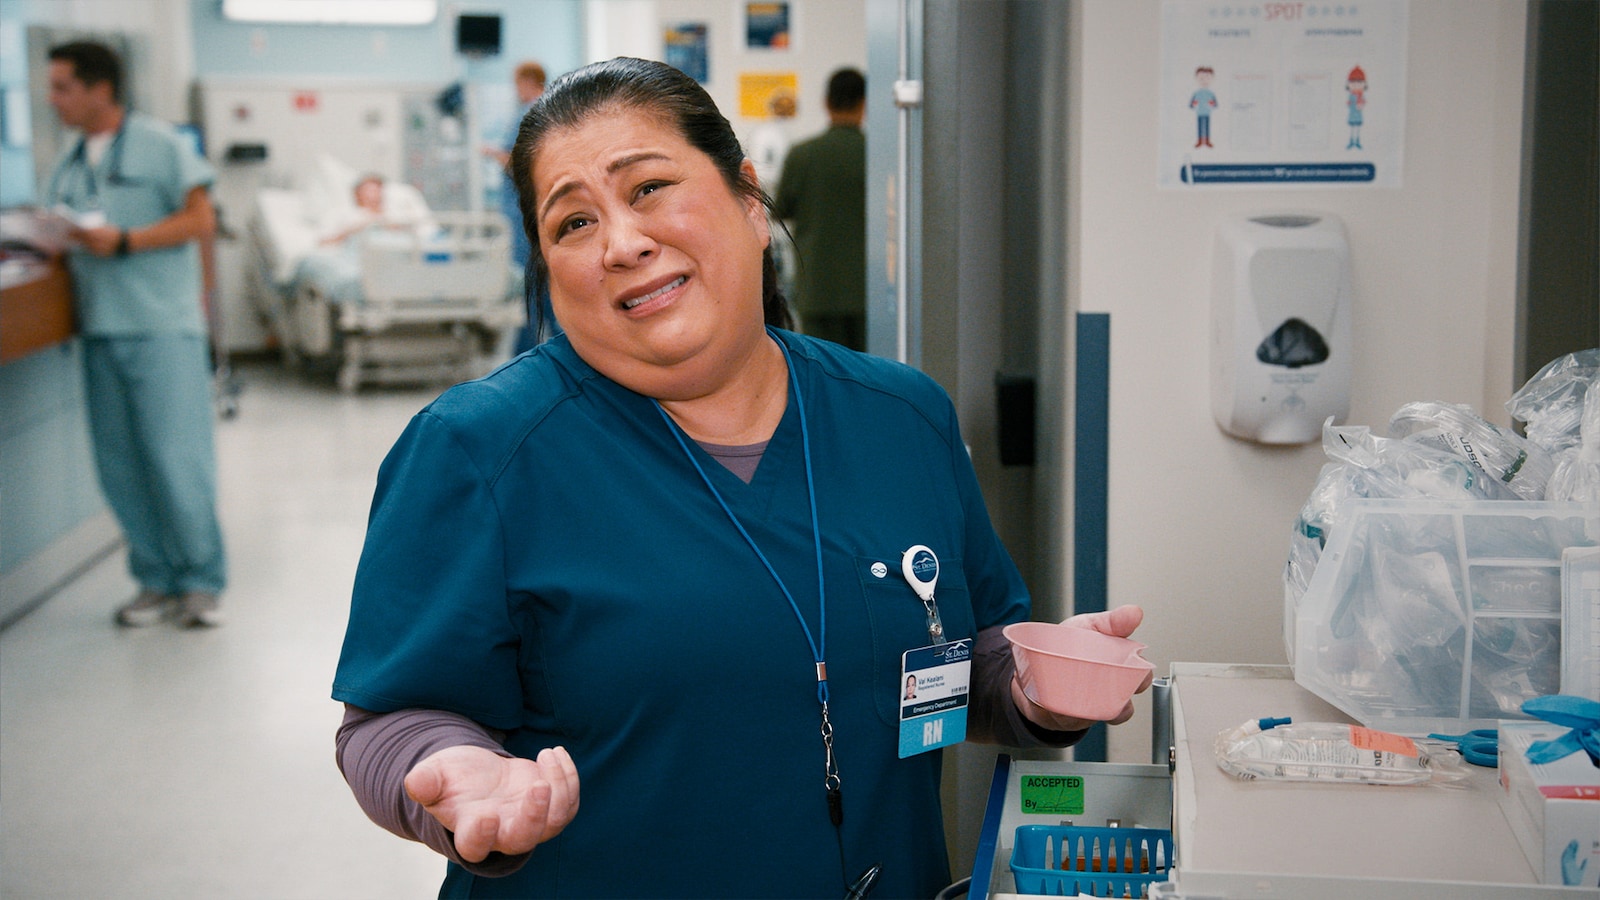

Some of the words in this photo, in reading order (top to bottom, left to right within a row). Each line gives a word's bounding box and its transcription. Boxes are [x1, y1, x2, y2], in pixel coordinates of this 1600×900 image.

[1264, 4, 1303, 21] SPOT
[913, 705, 935, 714] Emergency
[935, 699, 957, 710] Department
[923, 718, 943, 746] RN
[1027, 778, 1080, 788] ACCEPTED
[1025, 799, 1037, 809] By
